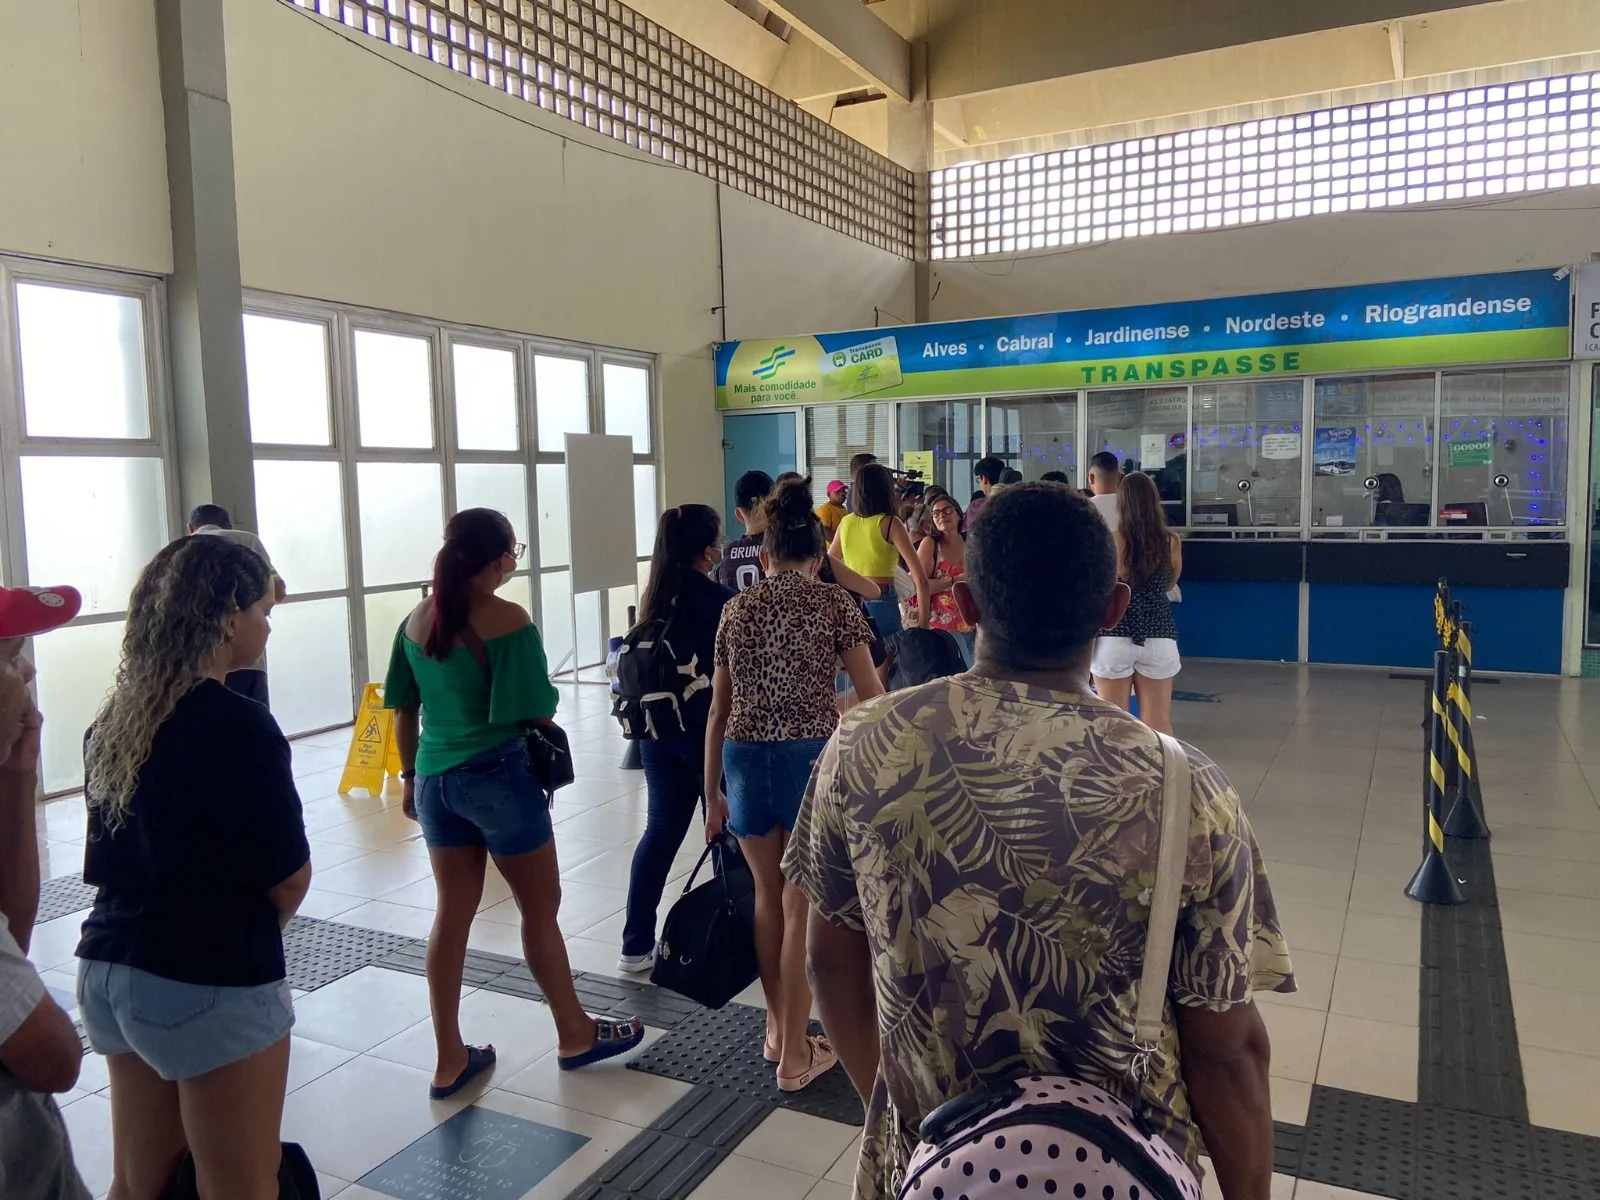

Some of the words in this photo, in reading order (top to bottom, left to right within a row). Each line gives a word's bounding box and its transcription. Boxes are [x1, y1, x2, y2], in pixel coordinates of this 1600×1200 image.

[923, 342, 967, 358] Alves
[996, 332, 1054, 352] Cabral
[1084, 325, 1190, 346] Jardinense
[1226, 311, 1325, 334] Nordeste
[1365, 297, 1532, 324] Riograndense
[851, 347, 883, 364] CARD
[1081, 352, 1300, 384] TRANSPASSE
[734, 383, 756, 394] Mais
[759, 380, 817, 392] comodidade
[751, 393, 771, 404] para
